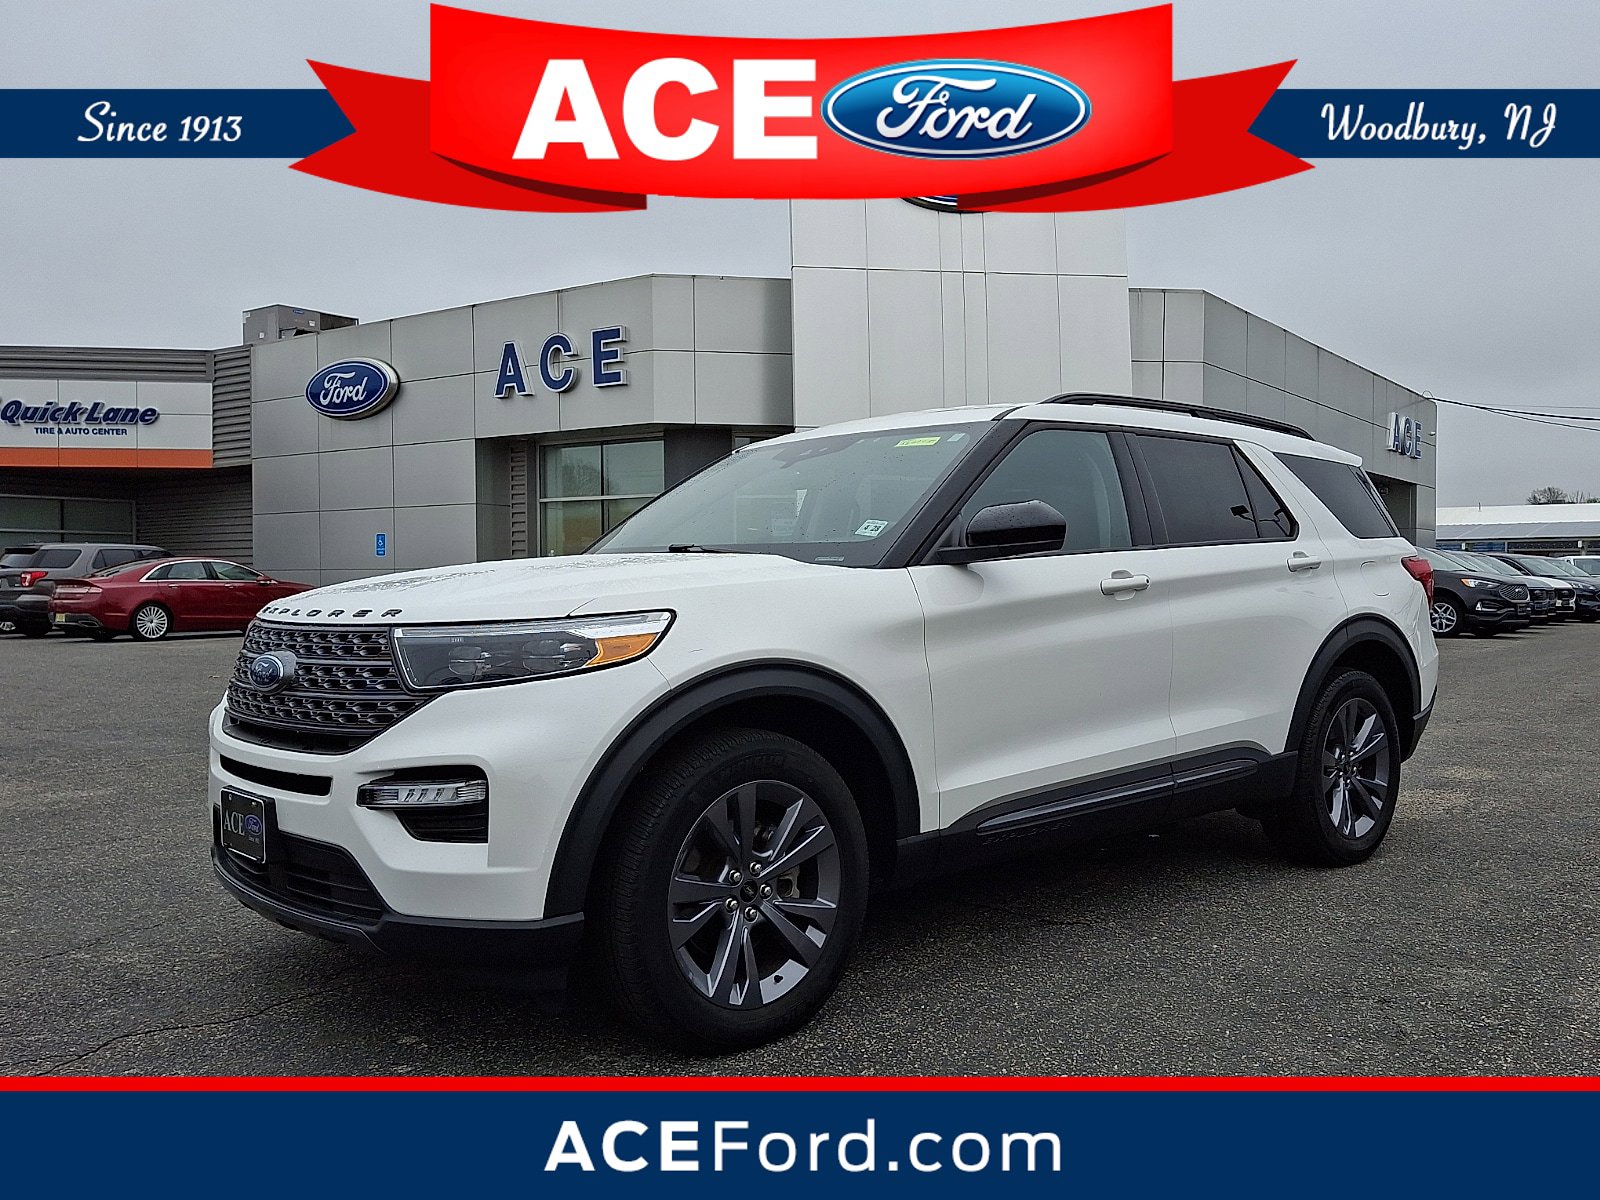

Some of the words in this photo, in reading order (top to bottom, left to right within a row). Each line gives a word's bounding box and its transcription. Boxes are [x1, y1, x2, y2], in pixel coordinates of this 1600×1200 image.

[494, 325, 628, 399] ACE
[319, 371, 367, 405] Ford
[34, 427, 55, 435] TIRE
[65, 427, 90, 435] AUTO
[92, 427, 128, 436] CENTER
[1387, 412, 1422, 459] ACE
[223, 808, 245, 836] ACE
